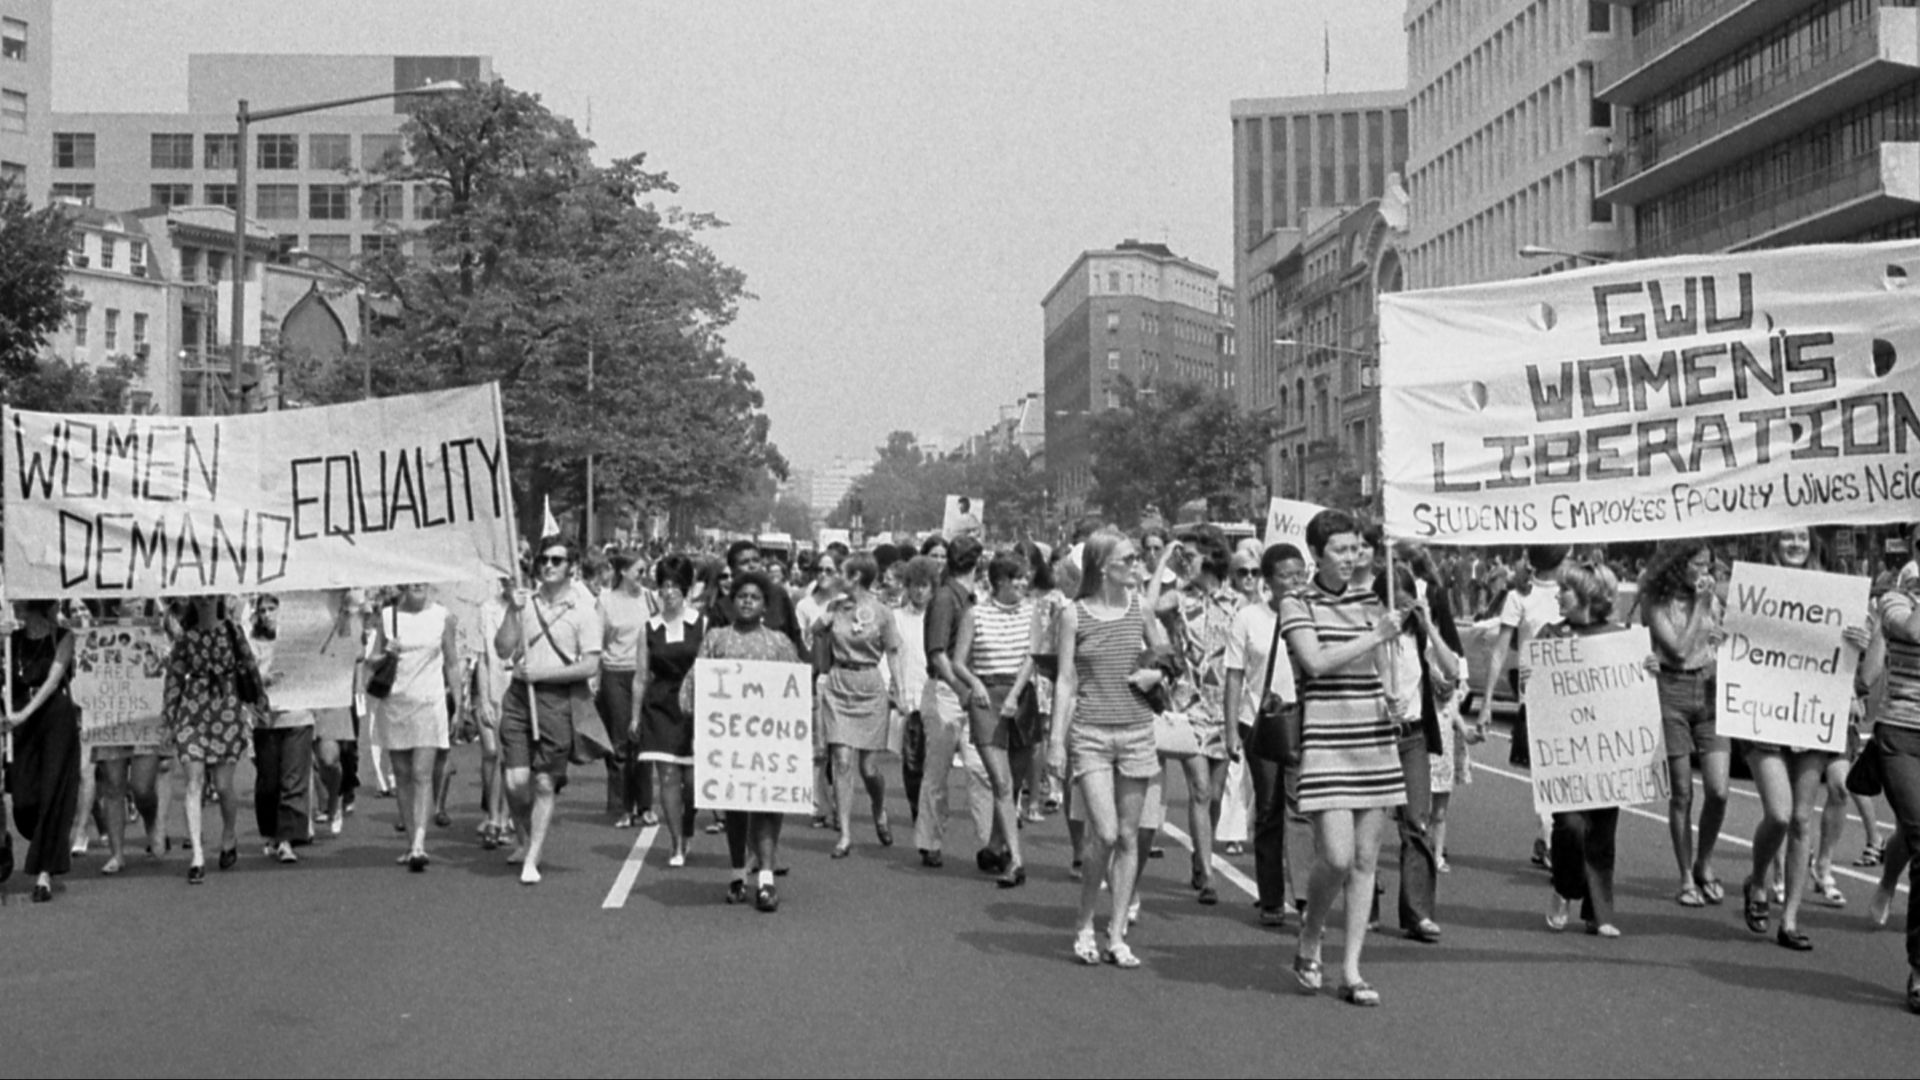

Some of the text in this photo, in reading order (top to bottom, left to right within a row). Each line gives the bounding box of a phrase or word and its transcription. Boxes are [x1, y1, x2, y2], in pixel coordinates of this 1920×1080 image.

[1592, 272, 1752, 345] GWU
[1525, 329, 1837, 422] WOMEN'S
[14, 412, 220, 501] WOMEN
[1431, 391, 1920, 493] LIBERATION
[59, 437, 501, 590] DEMAND EQUALITY
[1738, 583, 1843, 627] Women
[1529, 639, 1584, 667] FREE
[1730, 632, 1841, 675] Demand
[783, 672, 800, 699] A
[1551, 661, 1645, 697] ABORTION
[708, 711, 809, 741] SECOND
[1570, 706, 1597, 725] ON
[1725, 682, 1835, 744] Equality
[707, 750, 799, 773] CLASS
[1536, 726, 1656, 768] DEMAND
